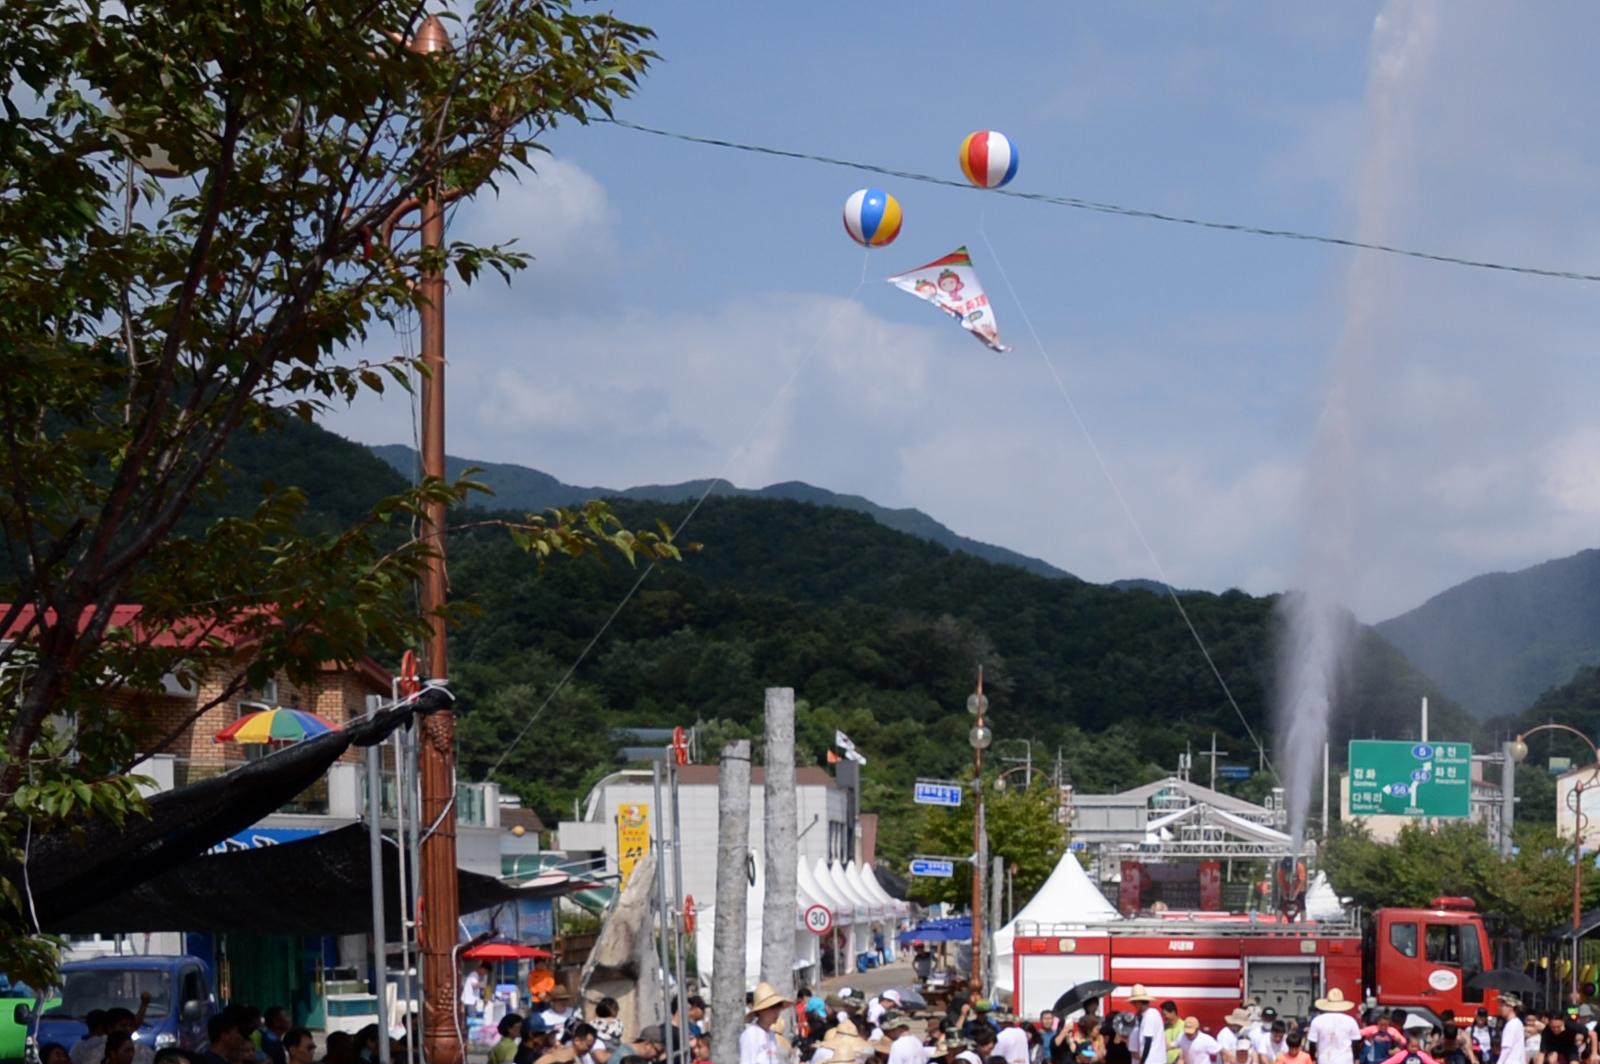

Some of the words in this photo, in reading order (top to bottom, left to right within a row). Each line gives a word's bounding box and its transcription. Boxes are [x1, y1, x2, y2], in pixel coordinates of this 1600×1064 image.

[1418, 746, 1426, 757] 5
[1414, 771, 1428, 781] 56
[1394, 784, 1406, 795] 56
[811, 911, 826, 926] 30
